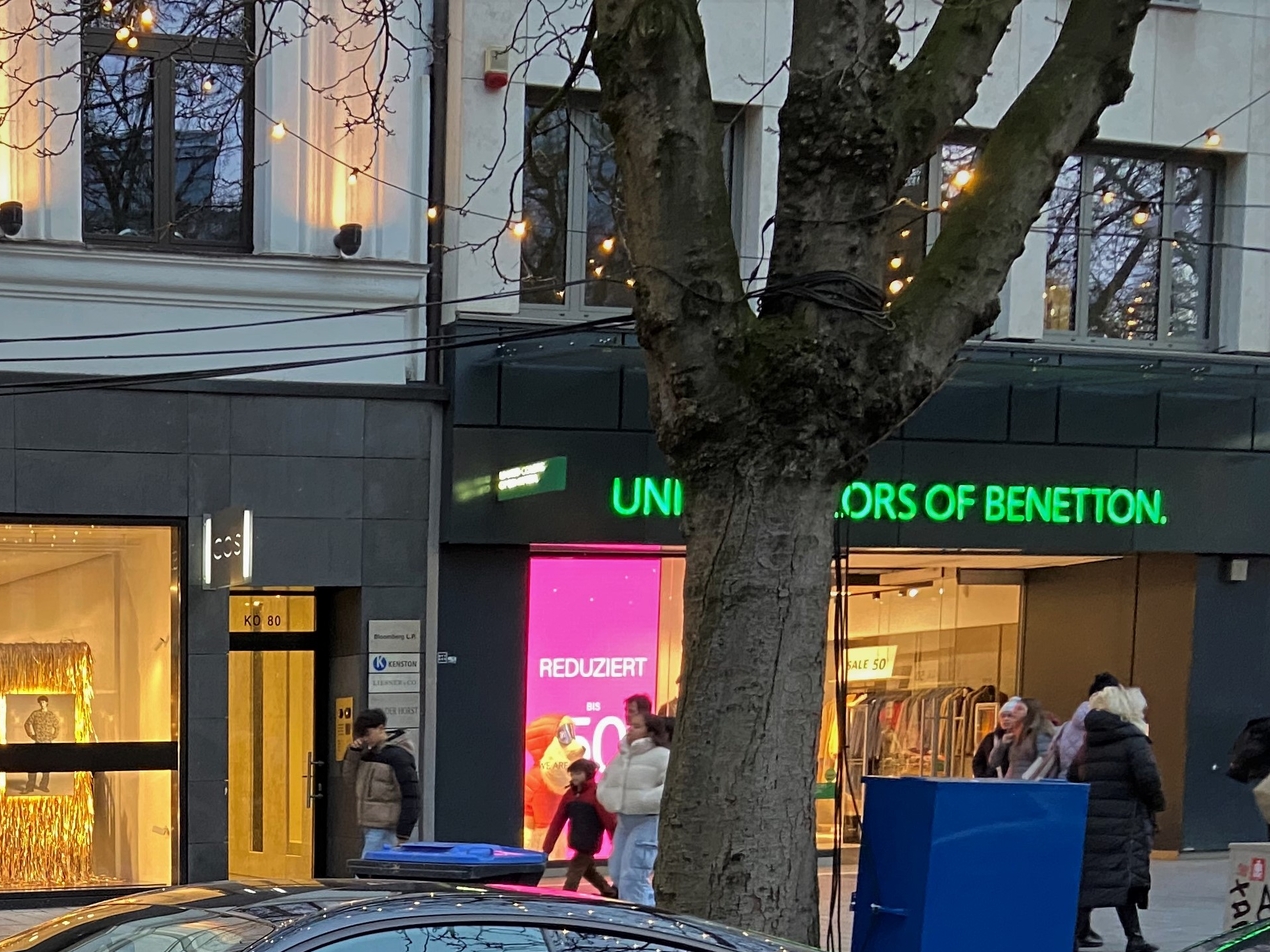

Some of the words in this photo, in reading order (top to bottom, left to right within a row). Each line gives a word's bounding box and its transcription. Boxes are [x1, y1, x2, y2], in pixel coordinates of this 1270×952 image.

[613, 477, 683, 516] UNI
[834, 481, 916, 520] ORS
[925, 483, 975, 521] OF
[985, 485, 1167, 524] BENETTON.
[213, 533, 242, 560] COS
[267, 615, 281, 626] 80
[388, 660, 417, 668] KENSTON
[539, 657, 648, 678] REDUZIERT
[847, 659, 869, 670] SALE
[872, 658, 887, 670] 50
[586, 701, 601, 711] BIS
